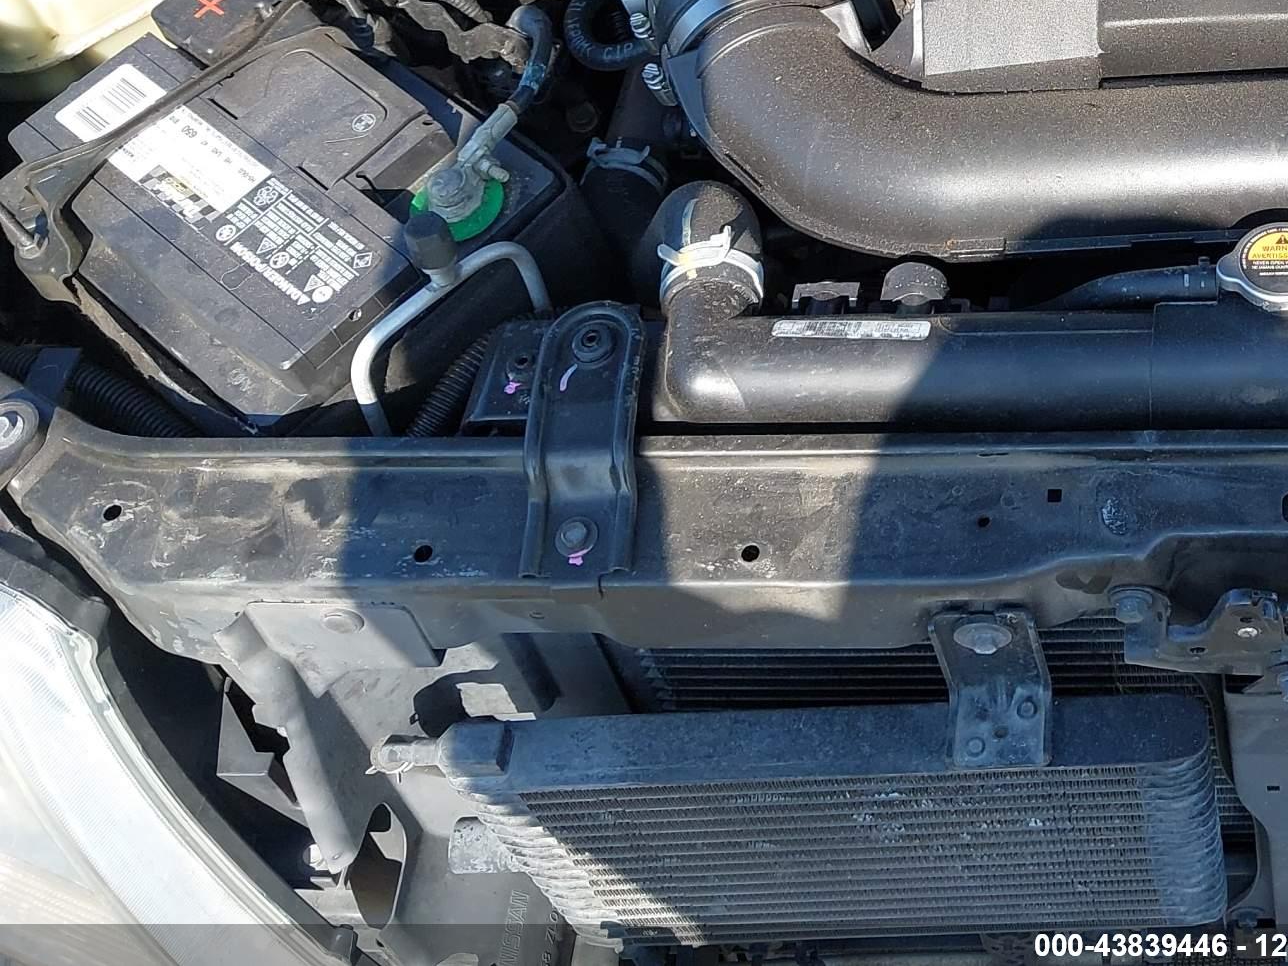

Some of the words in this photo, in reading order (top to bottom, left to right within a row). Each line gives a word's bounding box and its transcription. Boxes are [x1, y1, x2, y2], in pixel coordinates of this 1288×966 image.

[178, 123, 199, 140] 650
[227, 239, 304, 301] DANGER/POISON
[499, 889, 529, 966] NISSAN
